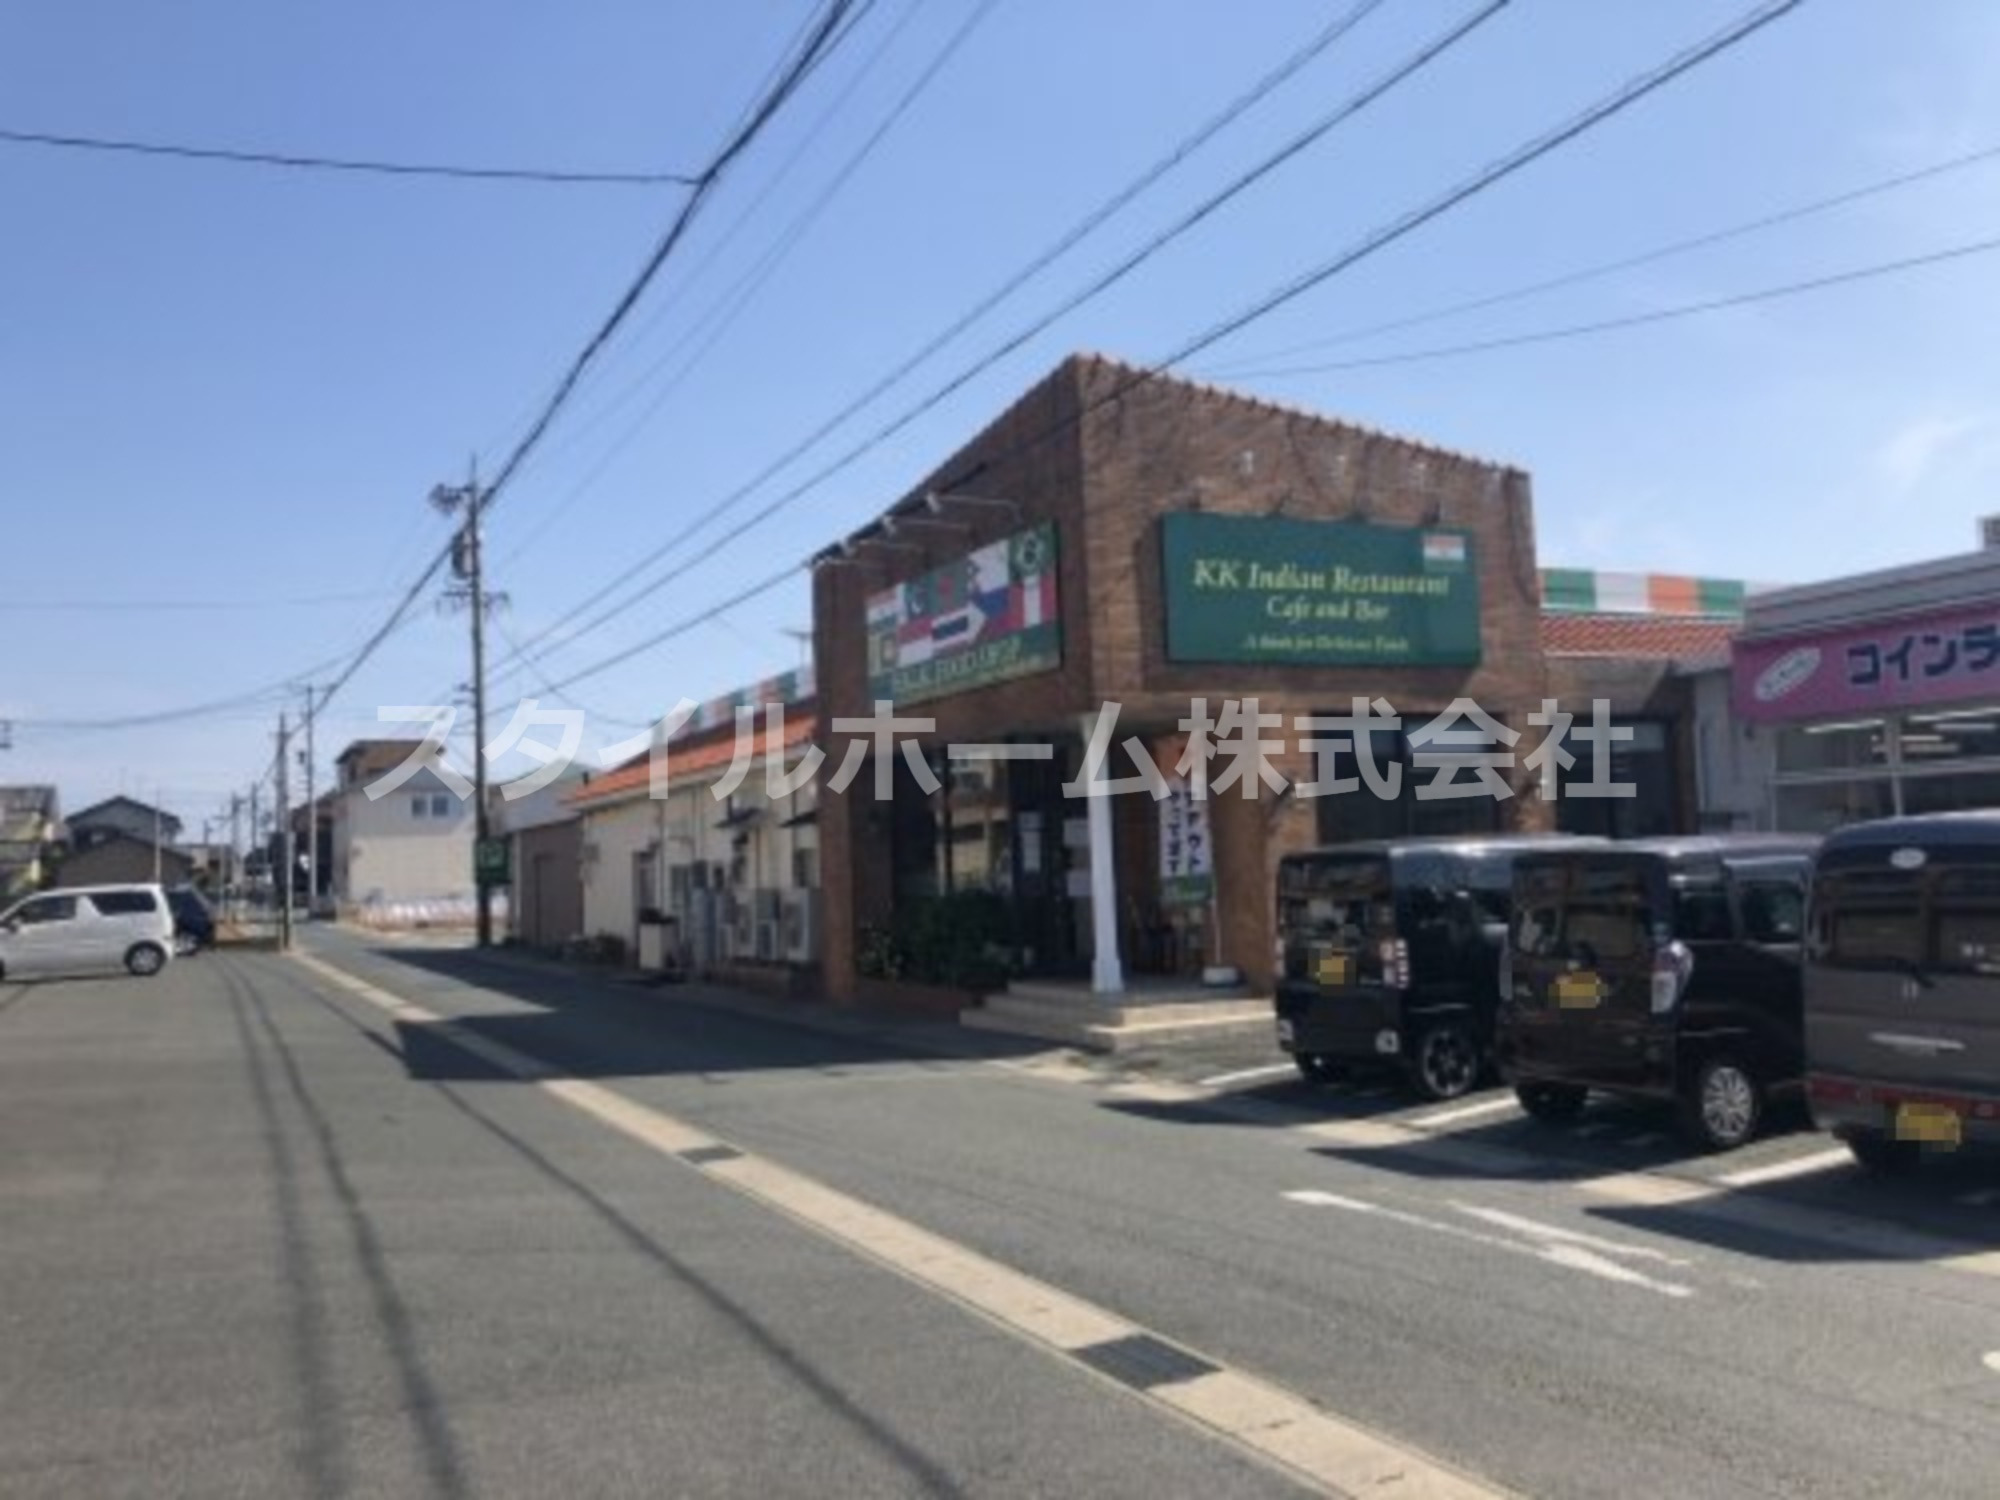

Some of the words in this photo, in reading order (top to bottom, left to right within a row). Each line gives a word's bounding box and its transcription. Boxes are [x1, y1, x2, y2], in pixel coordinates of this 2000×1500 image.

[1194, 559, 1241, 588] KK
[1247, 561, 1325, 590] Indian
[1332, 566, 1449, 595] Restaurant
[1314, 598, 1349, 619] and
[1354, 599, 1390, 622] Bar
